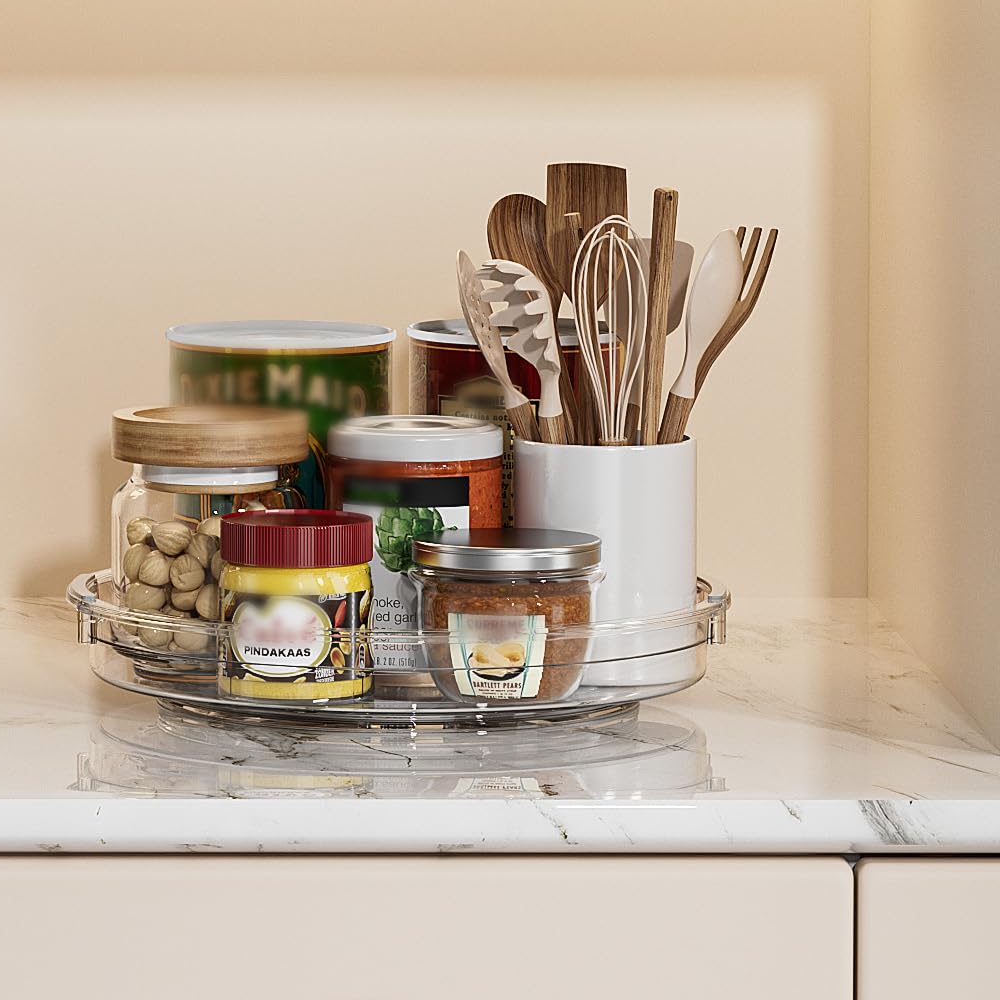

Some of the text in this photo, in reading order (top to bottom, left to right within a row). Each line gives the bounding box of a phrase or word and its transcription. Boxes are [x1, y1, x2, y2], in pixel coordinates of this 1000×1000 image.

[374, 596, 404, 610] oke,
[375, 611, 417, 625] ed garl
[244, 646, 311, 658] PINDAKAAS
